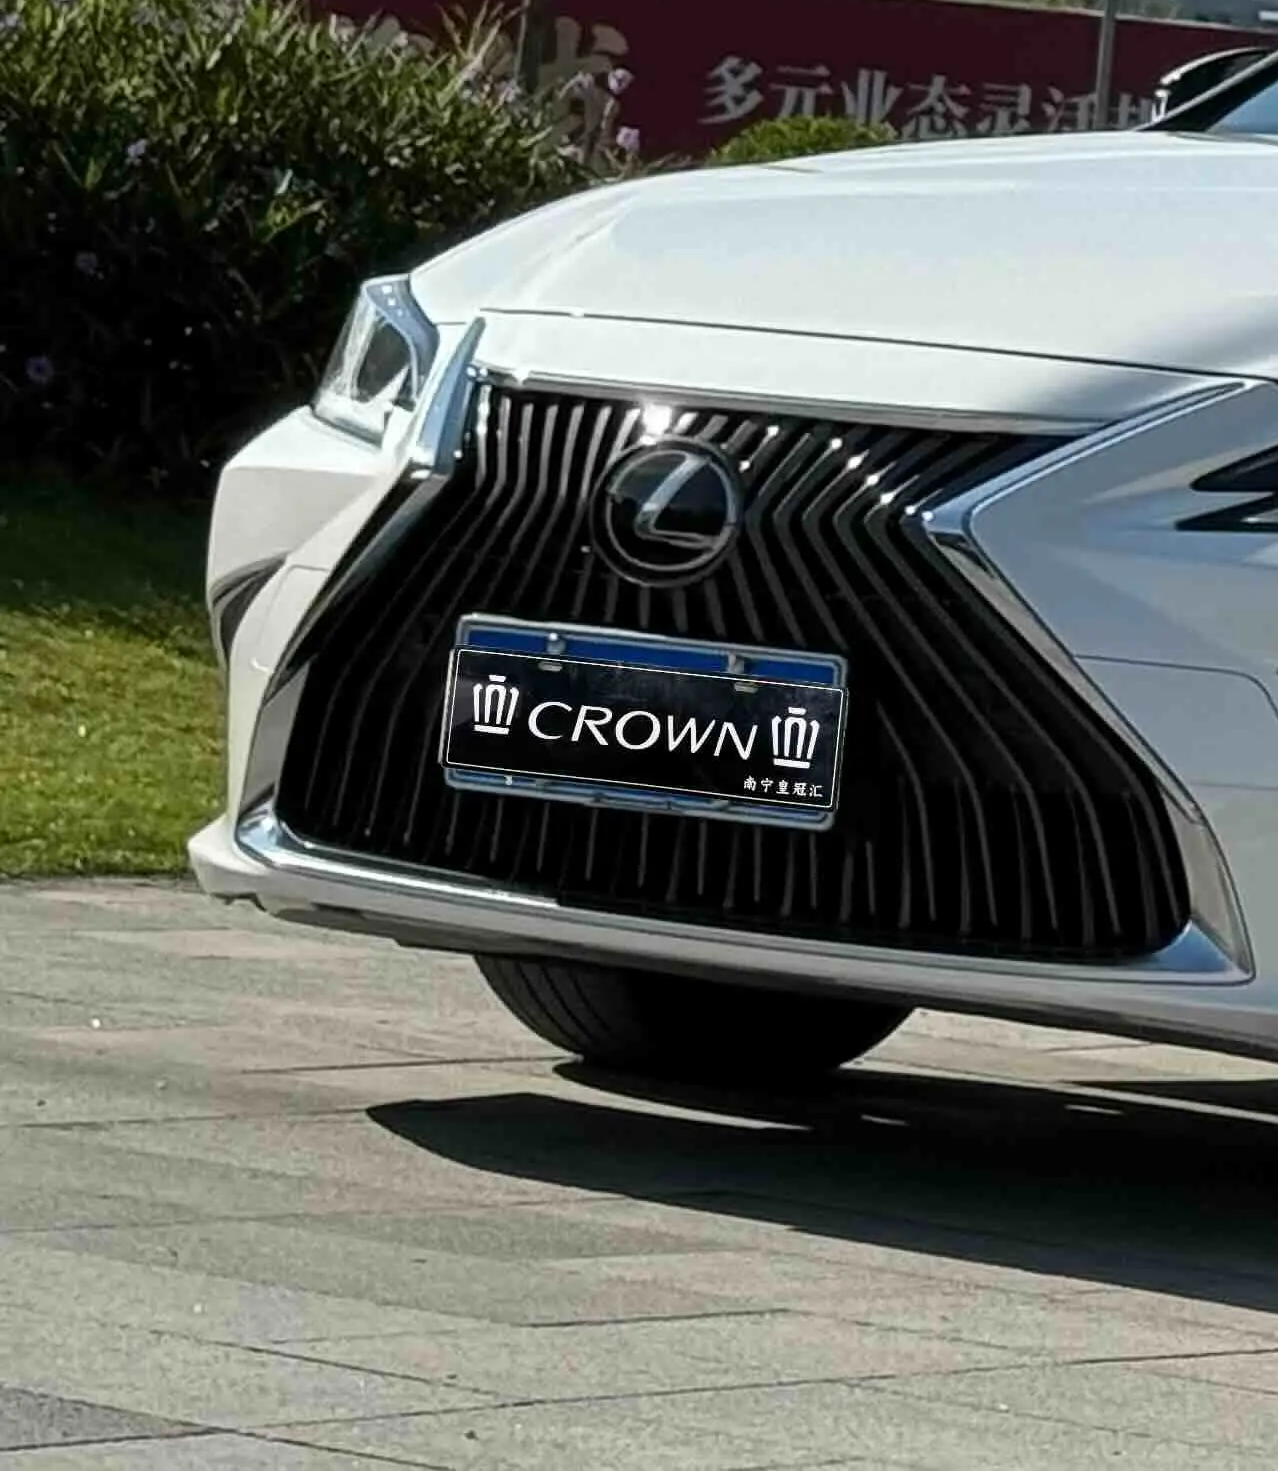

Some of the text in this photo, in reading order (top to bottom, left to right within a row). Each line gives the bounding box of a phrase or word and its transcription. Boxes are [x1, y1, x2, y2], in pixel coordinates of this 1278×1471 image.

[527, 701, 758, 761] CROWN
[743, 775, 824, 798] 南宁皇冠汇
